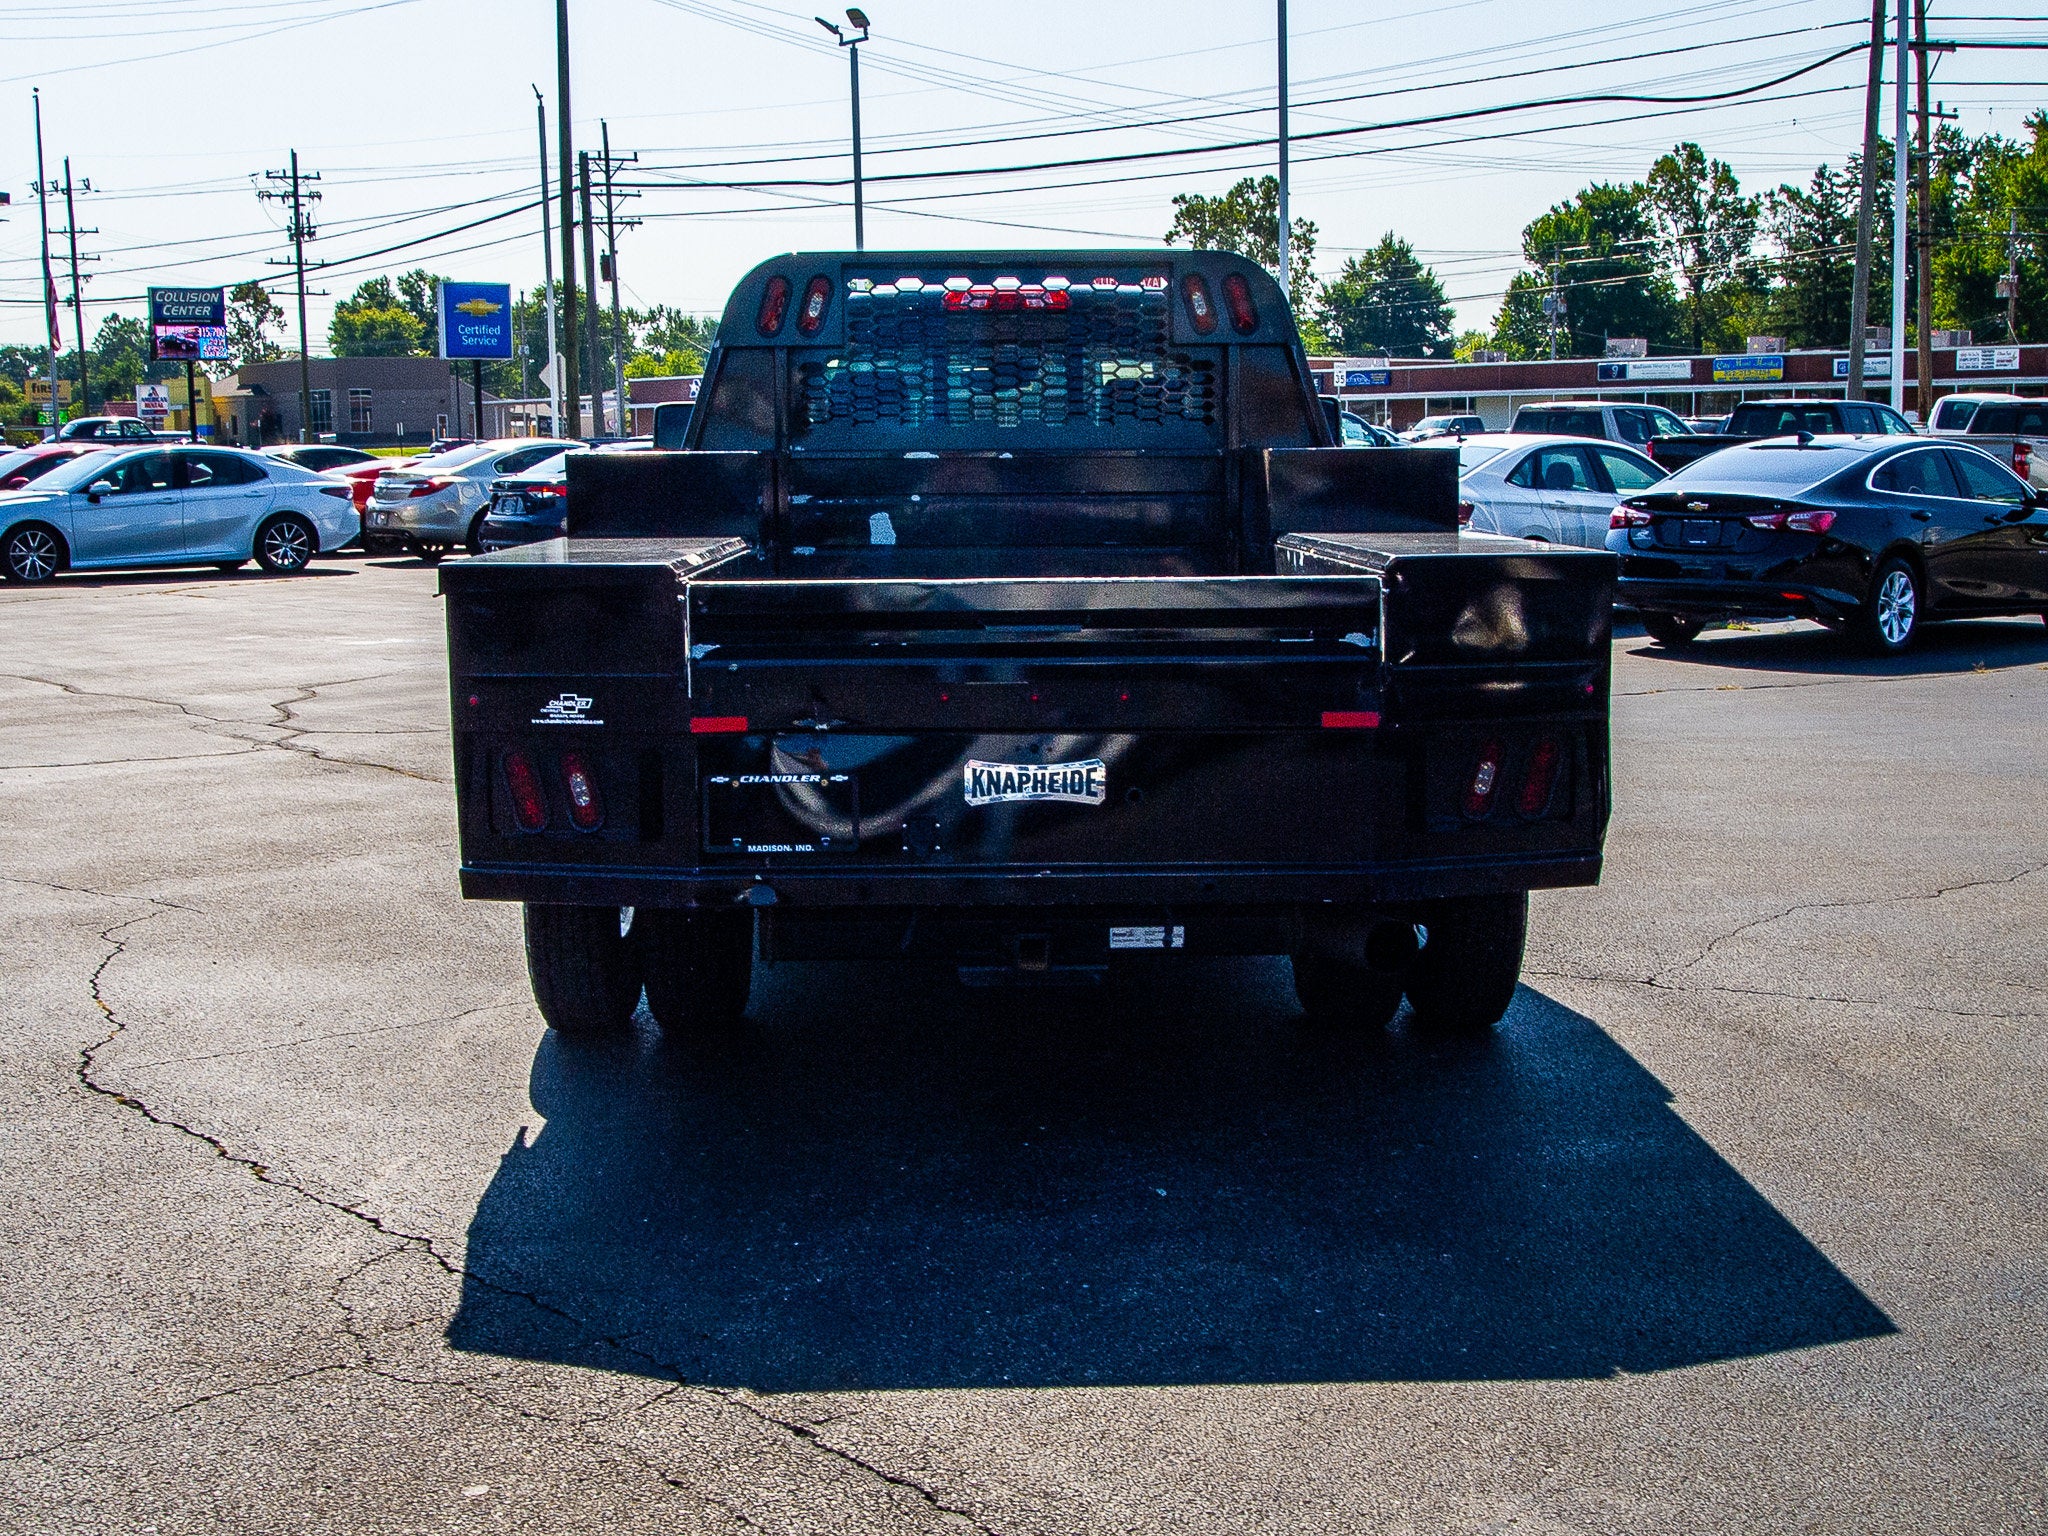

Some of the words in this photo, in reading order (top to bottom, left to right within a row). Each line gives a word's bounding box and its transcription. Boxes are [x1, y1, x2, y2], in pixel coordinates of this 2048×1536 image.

[155, 290, 219, 303] COLLISION
[163, 304, 211, 317] CENTER
[458, 324, 501, 335] Certified
[461, 335, 498, 346] Service
[1335, 374, 1345, 384] 35
[739, 774, 821, 784] CHANDLER
[971, 766, 1099, 799] KNAPHEIDE
[795, 844, 815, 852] IND.
